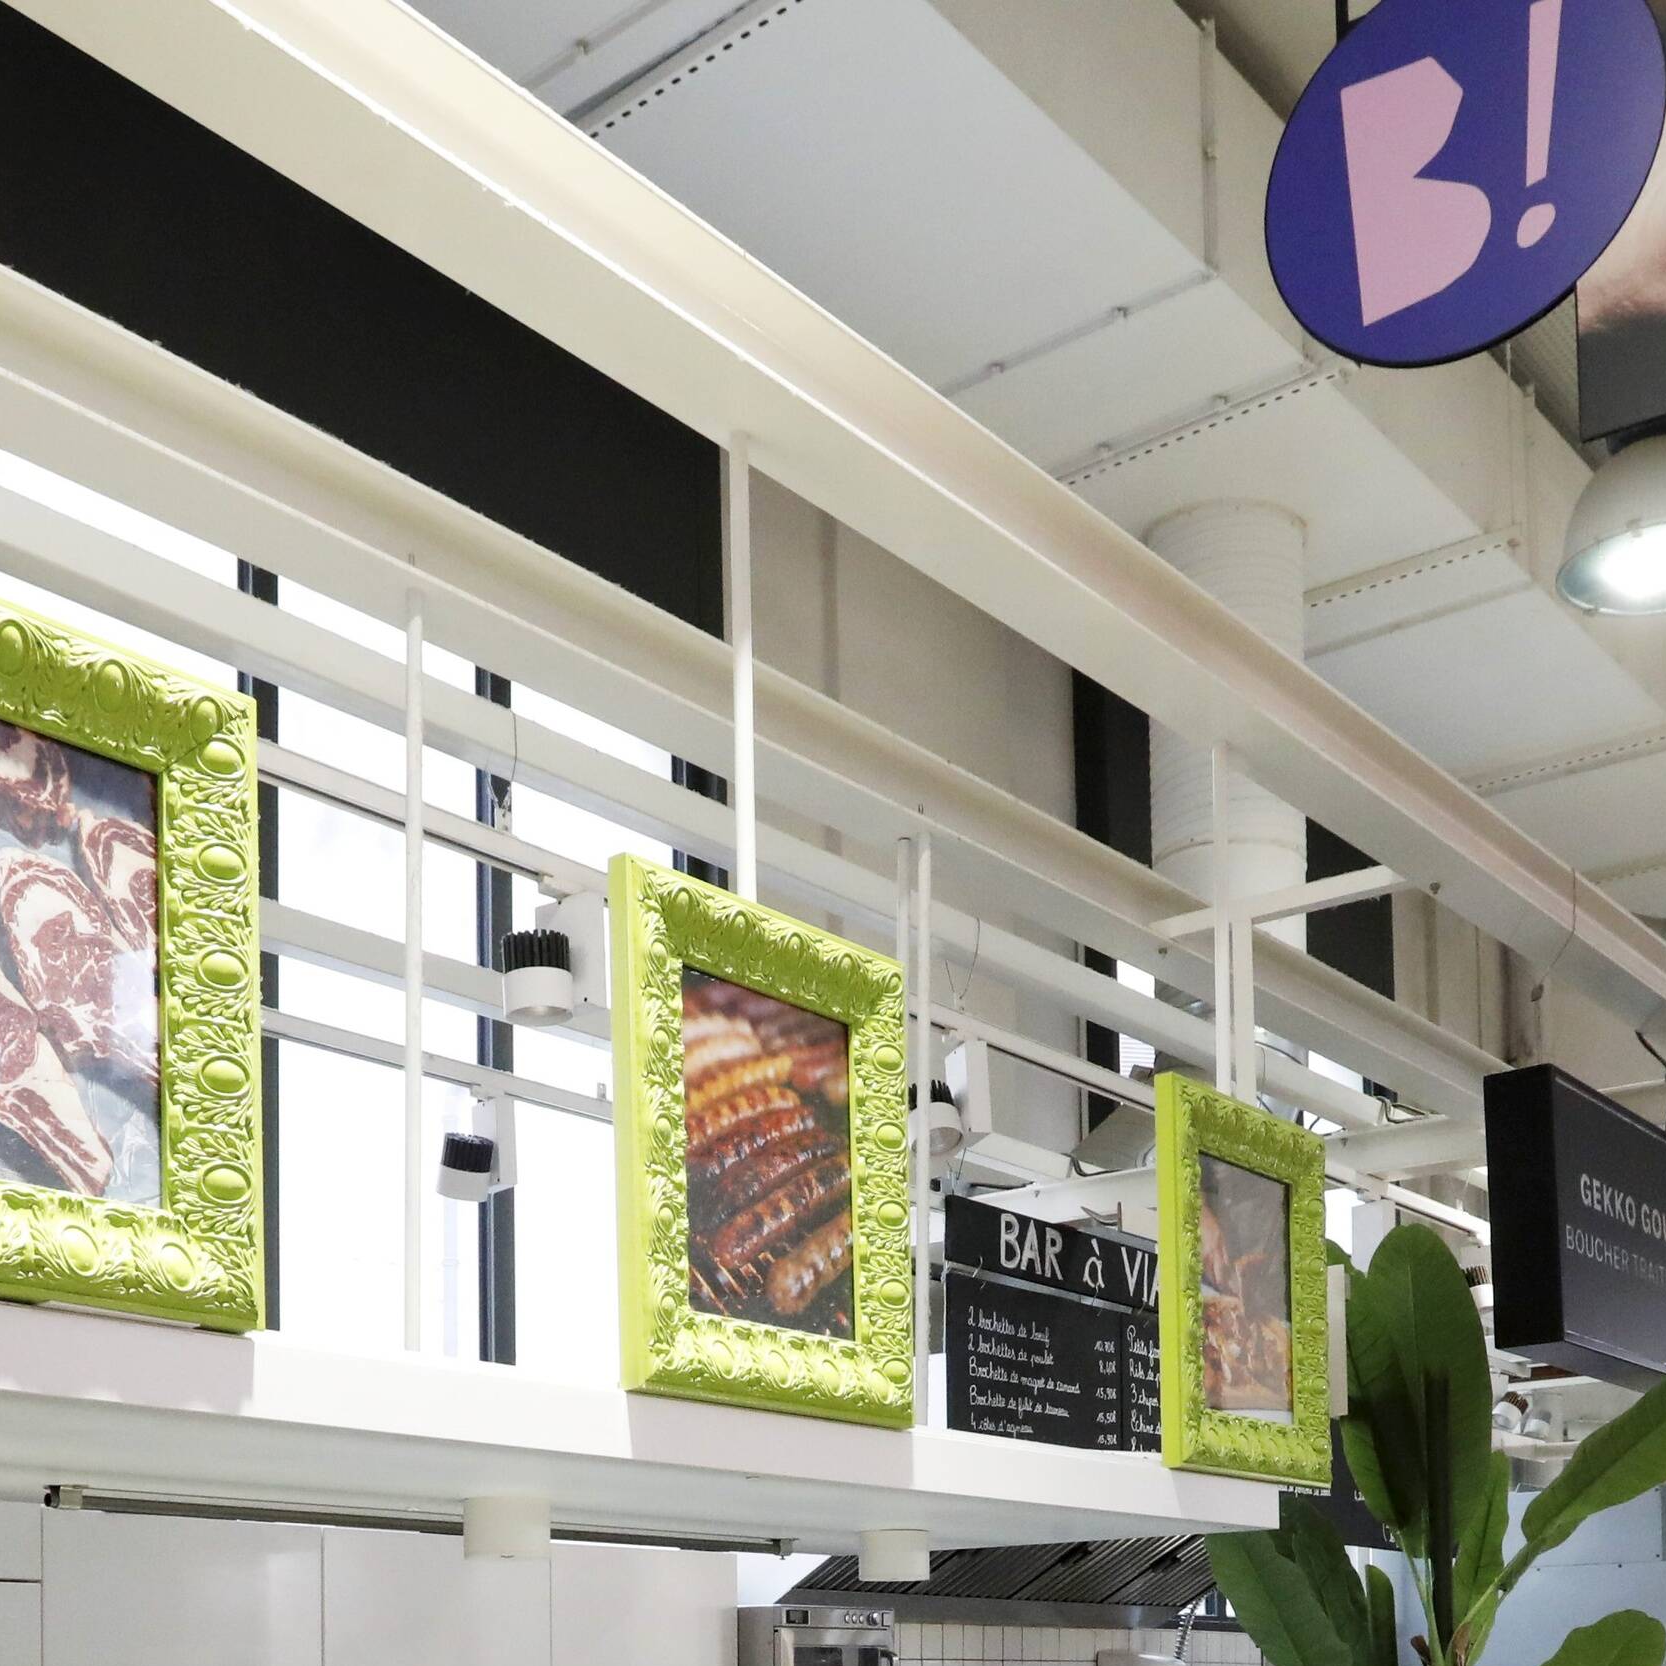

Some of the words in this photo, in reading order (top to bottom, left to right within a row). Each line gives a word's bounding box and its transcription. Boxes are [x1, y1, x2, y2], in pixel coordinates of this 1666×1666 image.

[1341, 0, 1563, 327] B!
[1580, 1173, 1637, 1227] GEKKO
[999, 1212, 1064, 1281] BAR
[1083, 1238, 1105, 1289] à
[1565, 1224, 1629, 1273] BOUCHER
[1017, 1323, 1027, 1339] de
[968, 1355, 1008, 1382] Brochette
[1009, 1370, 1019, 1384] de
[1017, 1348, 1028, 1362] de
[1030, 1349, 1055, 1368] poulet
[969, 1384, 1006, 1409] Brochette
[1007, 1397, 1017, 1410] de
[1130, 1383, 1137, 1403] 3
